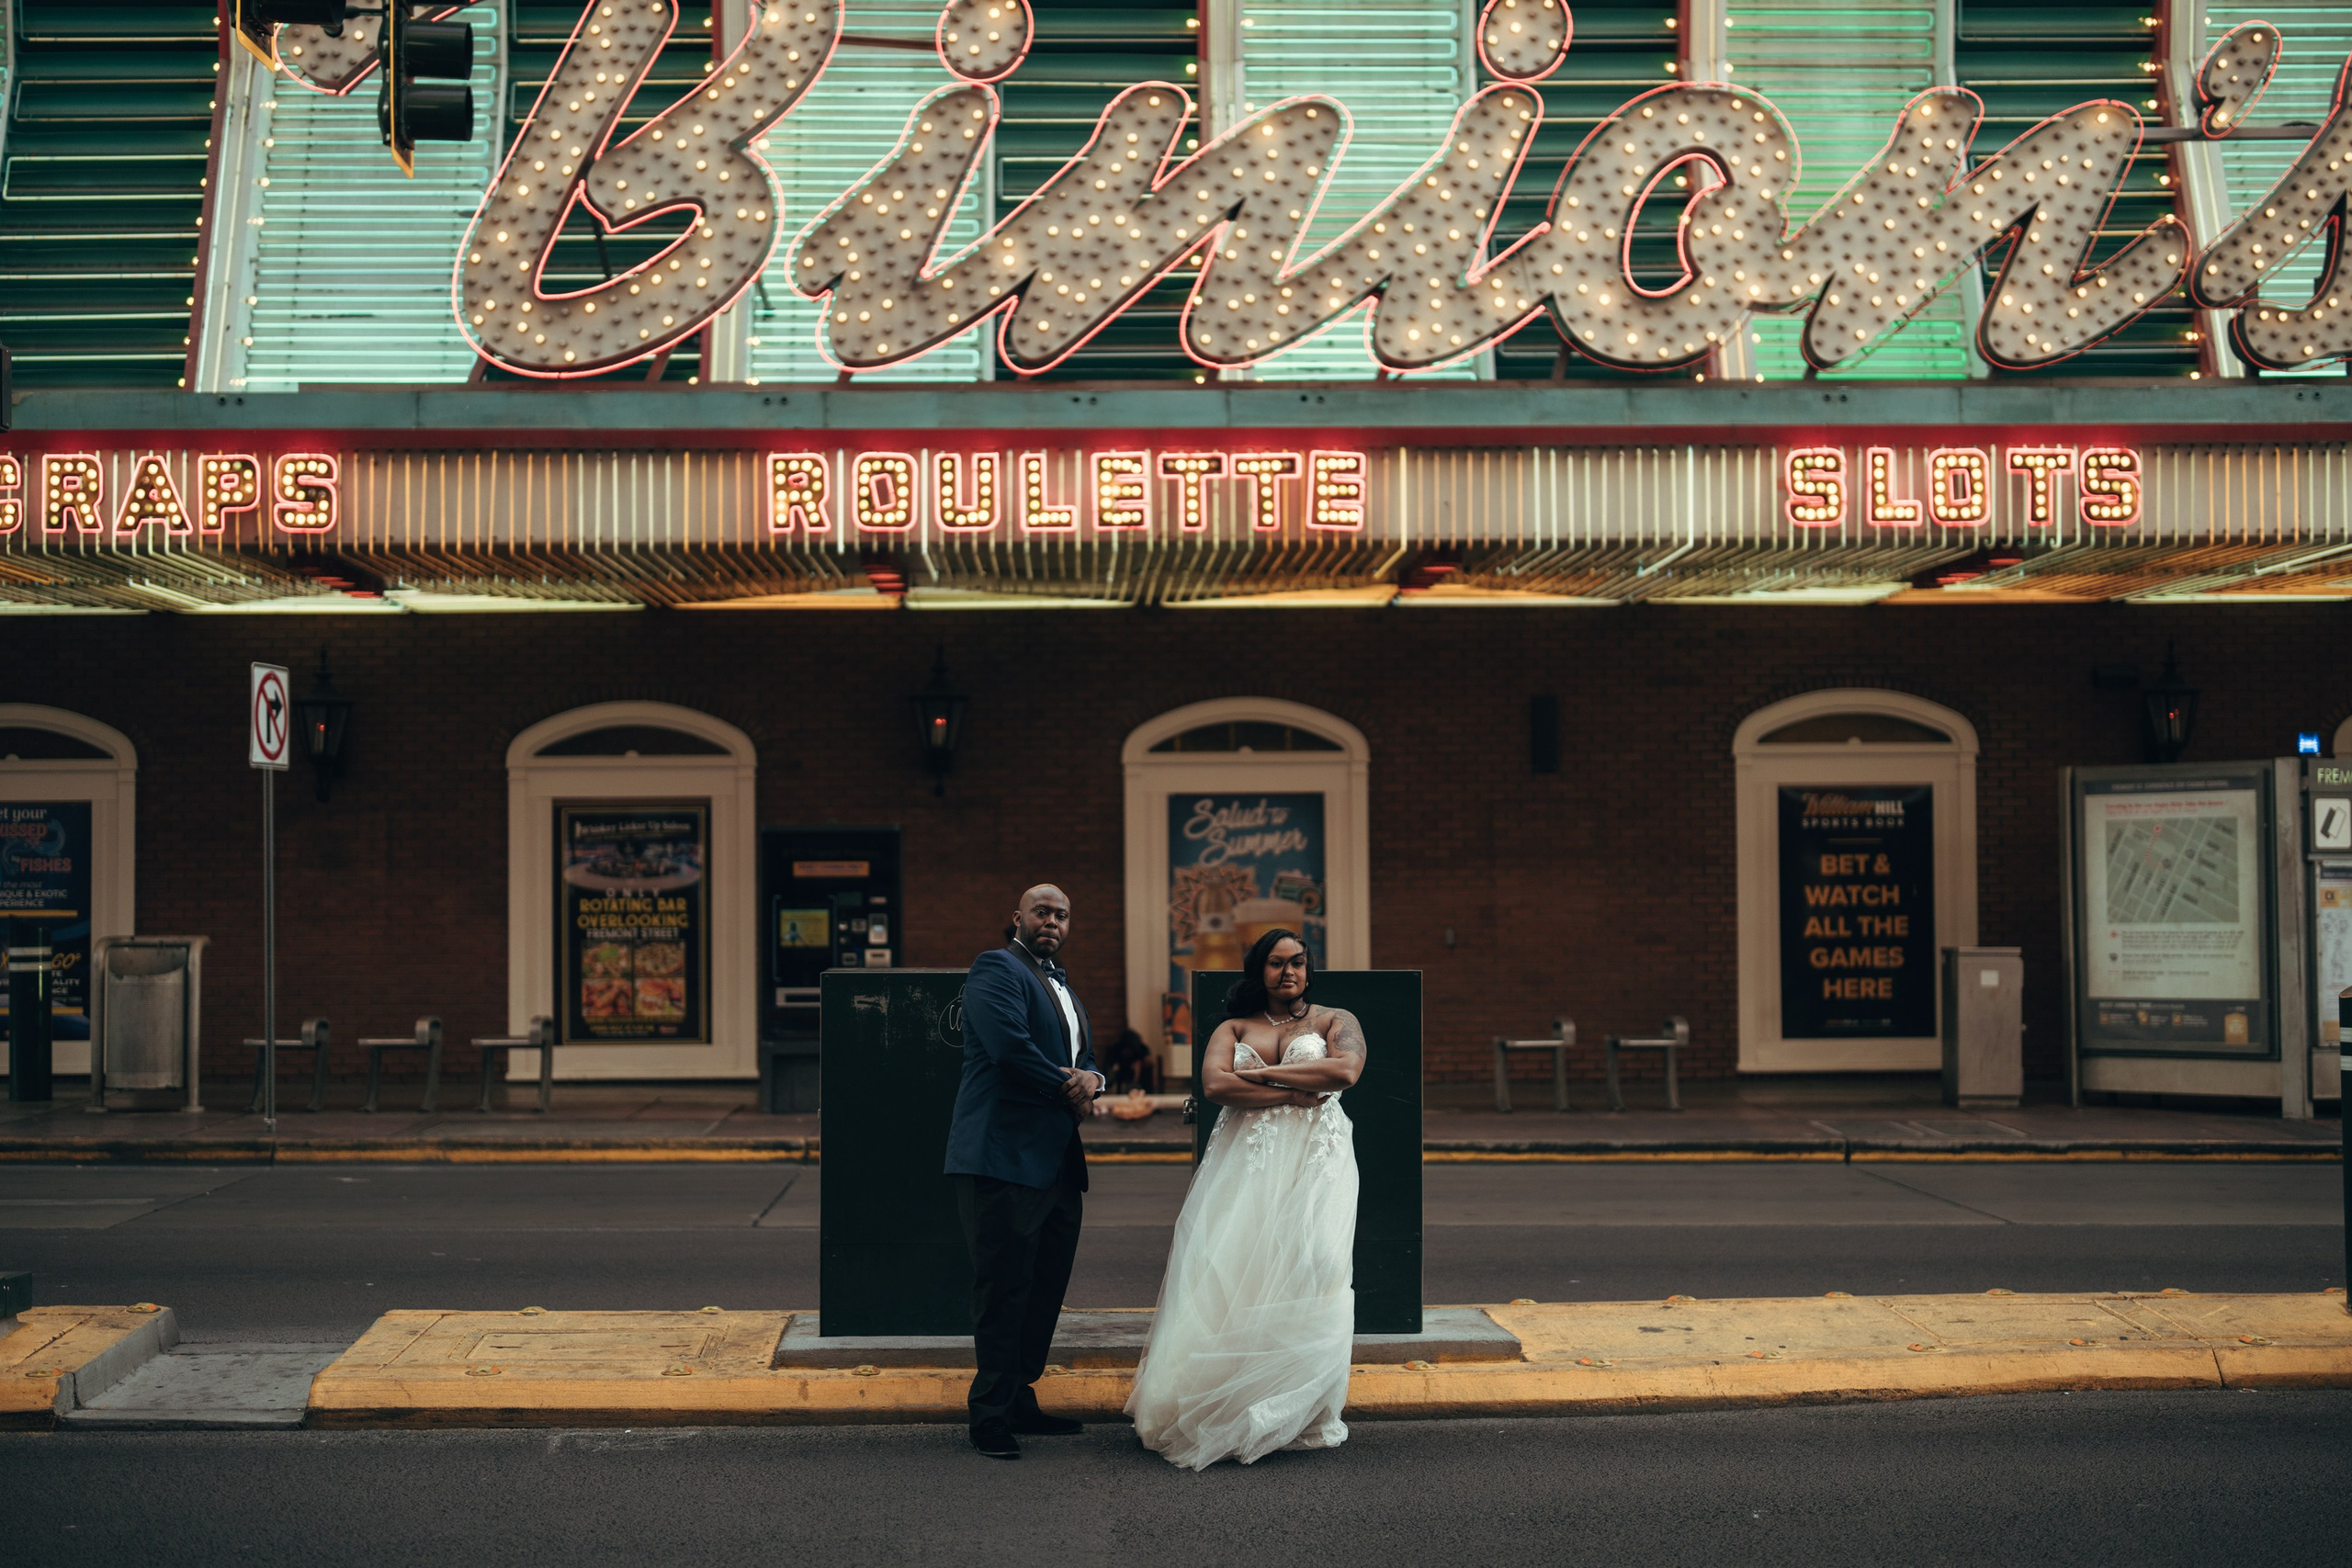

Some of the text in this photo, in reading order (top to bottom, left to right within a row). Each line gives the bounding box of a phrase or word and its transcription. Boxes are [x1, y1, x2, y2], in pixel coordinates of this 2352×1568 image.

[766, 449, 1367, 534] ROULETTE
[1784, 446, 2143, 527] SLOTS
[13, 808, 48, 822] your
[1874, 799, 1905, 817] HILL
[1182, 797, 1269, 840] Salud
[1802, 817, 1905, 829] SPORTS BOOK
[1198, 827, 1309, 868] Summer
[20, 857, 73, 873] FISHES
[1820, 852, 1892, 876] BET &
[34, 889, 68, 897] EXOTIC
[605, 886, 662, 897] ONLY
[1804, 884, 1901, 908] WATCH
[579, 897, 688, 913] ROTATING BAR
[576, 913, 690, 930] OVERLOOKING
[1804, 914, 1910, 939] ALL THE
[586, 927, 680, 938] FREMONT STREET
[1809, 946, 1905, 969] GAMES
[1822, 977, 1894, 1000] HERE
